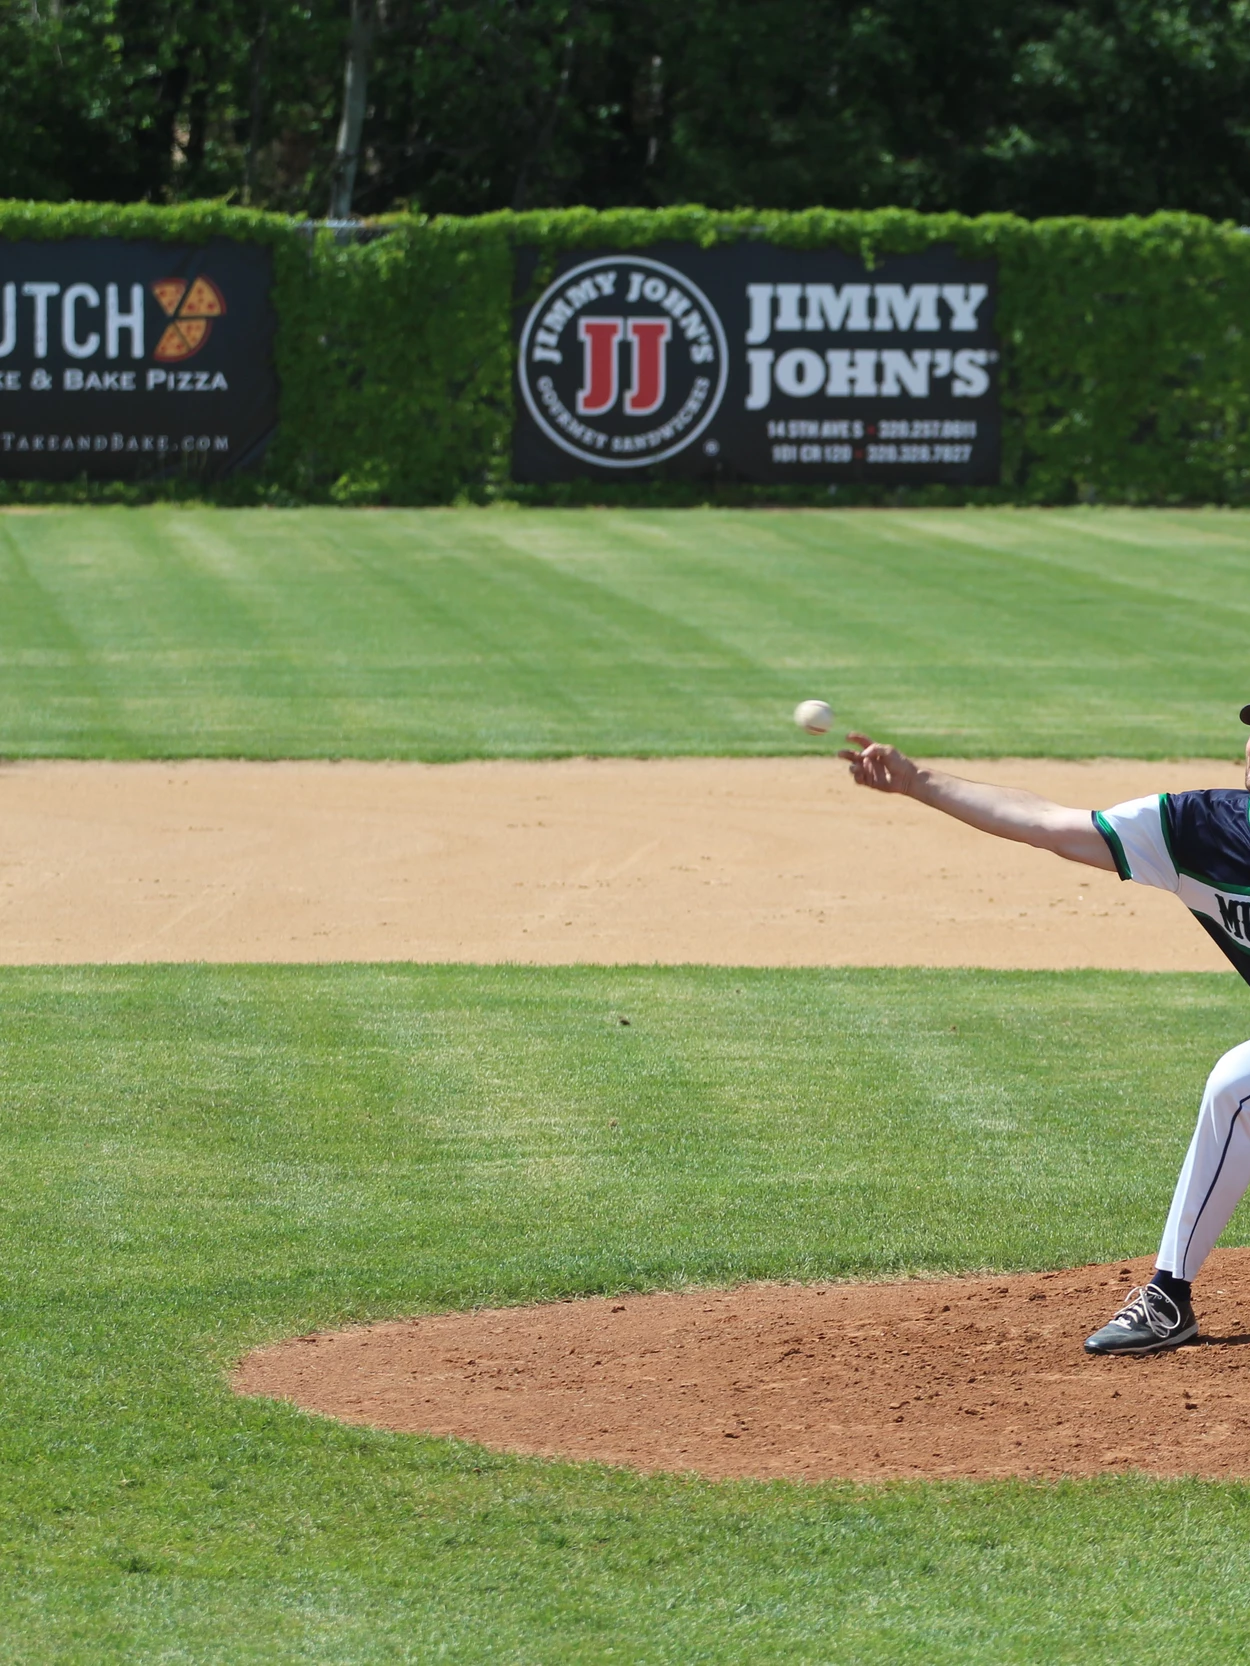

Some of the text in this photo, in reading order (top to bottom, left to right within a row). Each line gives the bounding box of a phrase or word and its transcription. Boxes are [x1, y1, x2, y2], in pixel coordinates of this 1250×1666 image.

[533, 270, 714, 364] JIMMY JOHN'S
[745, 283, 988, 345] JIMMY
[30, 368, 52, 390] &
[576, 316, 672, 416] JJ
[745, 348, 990, 411] JOHN'S
